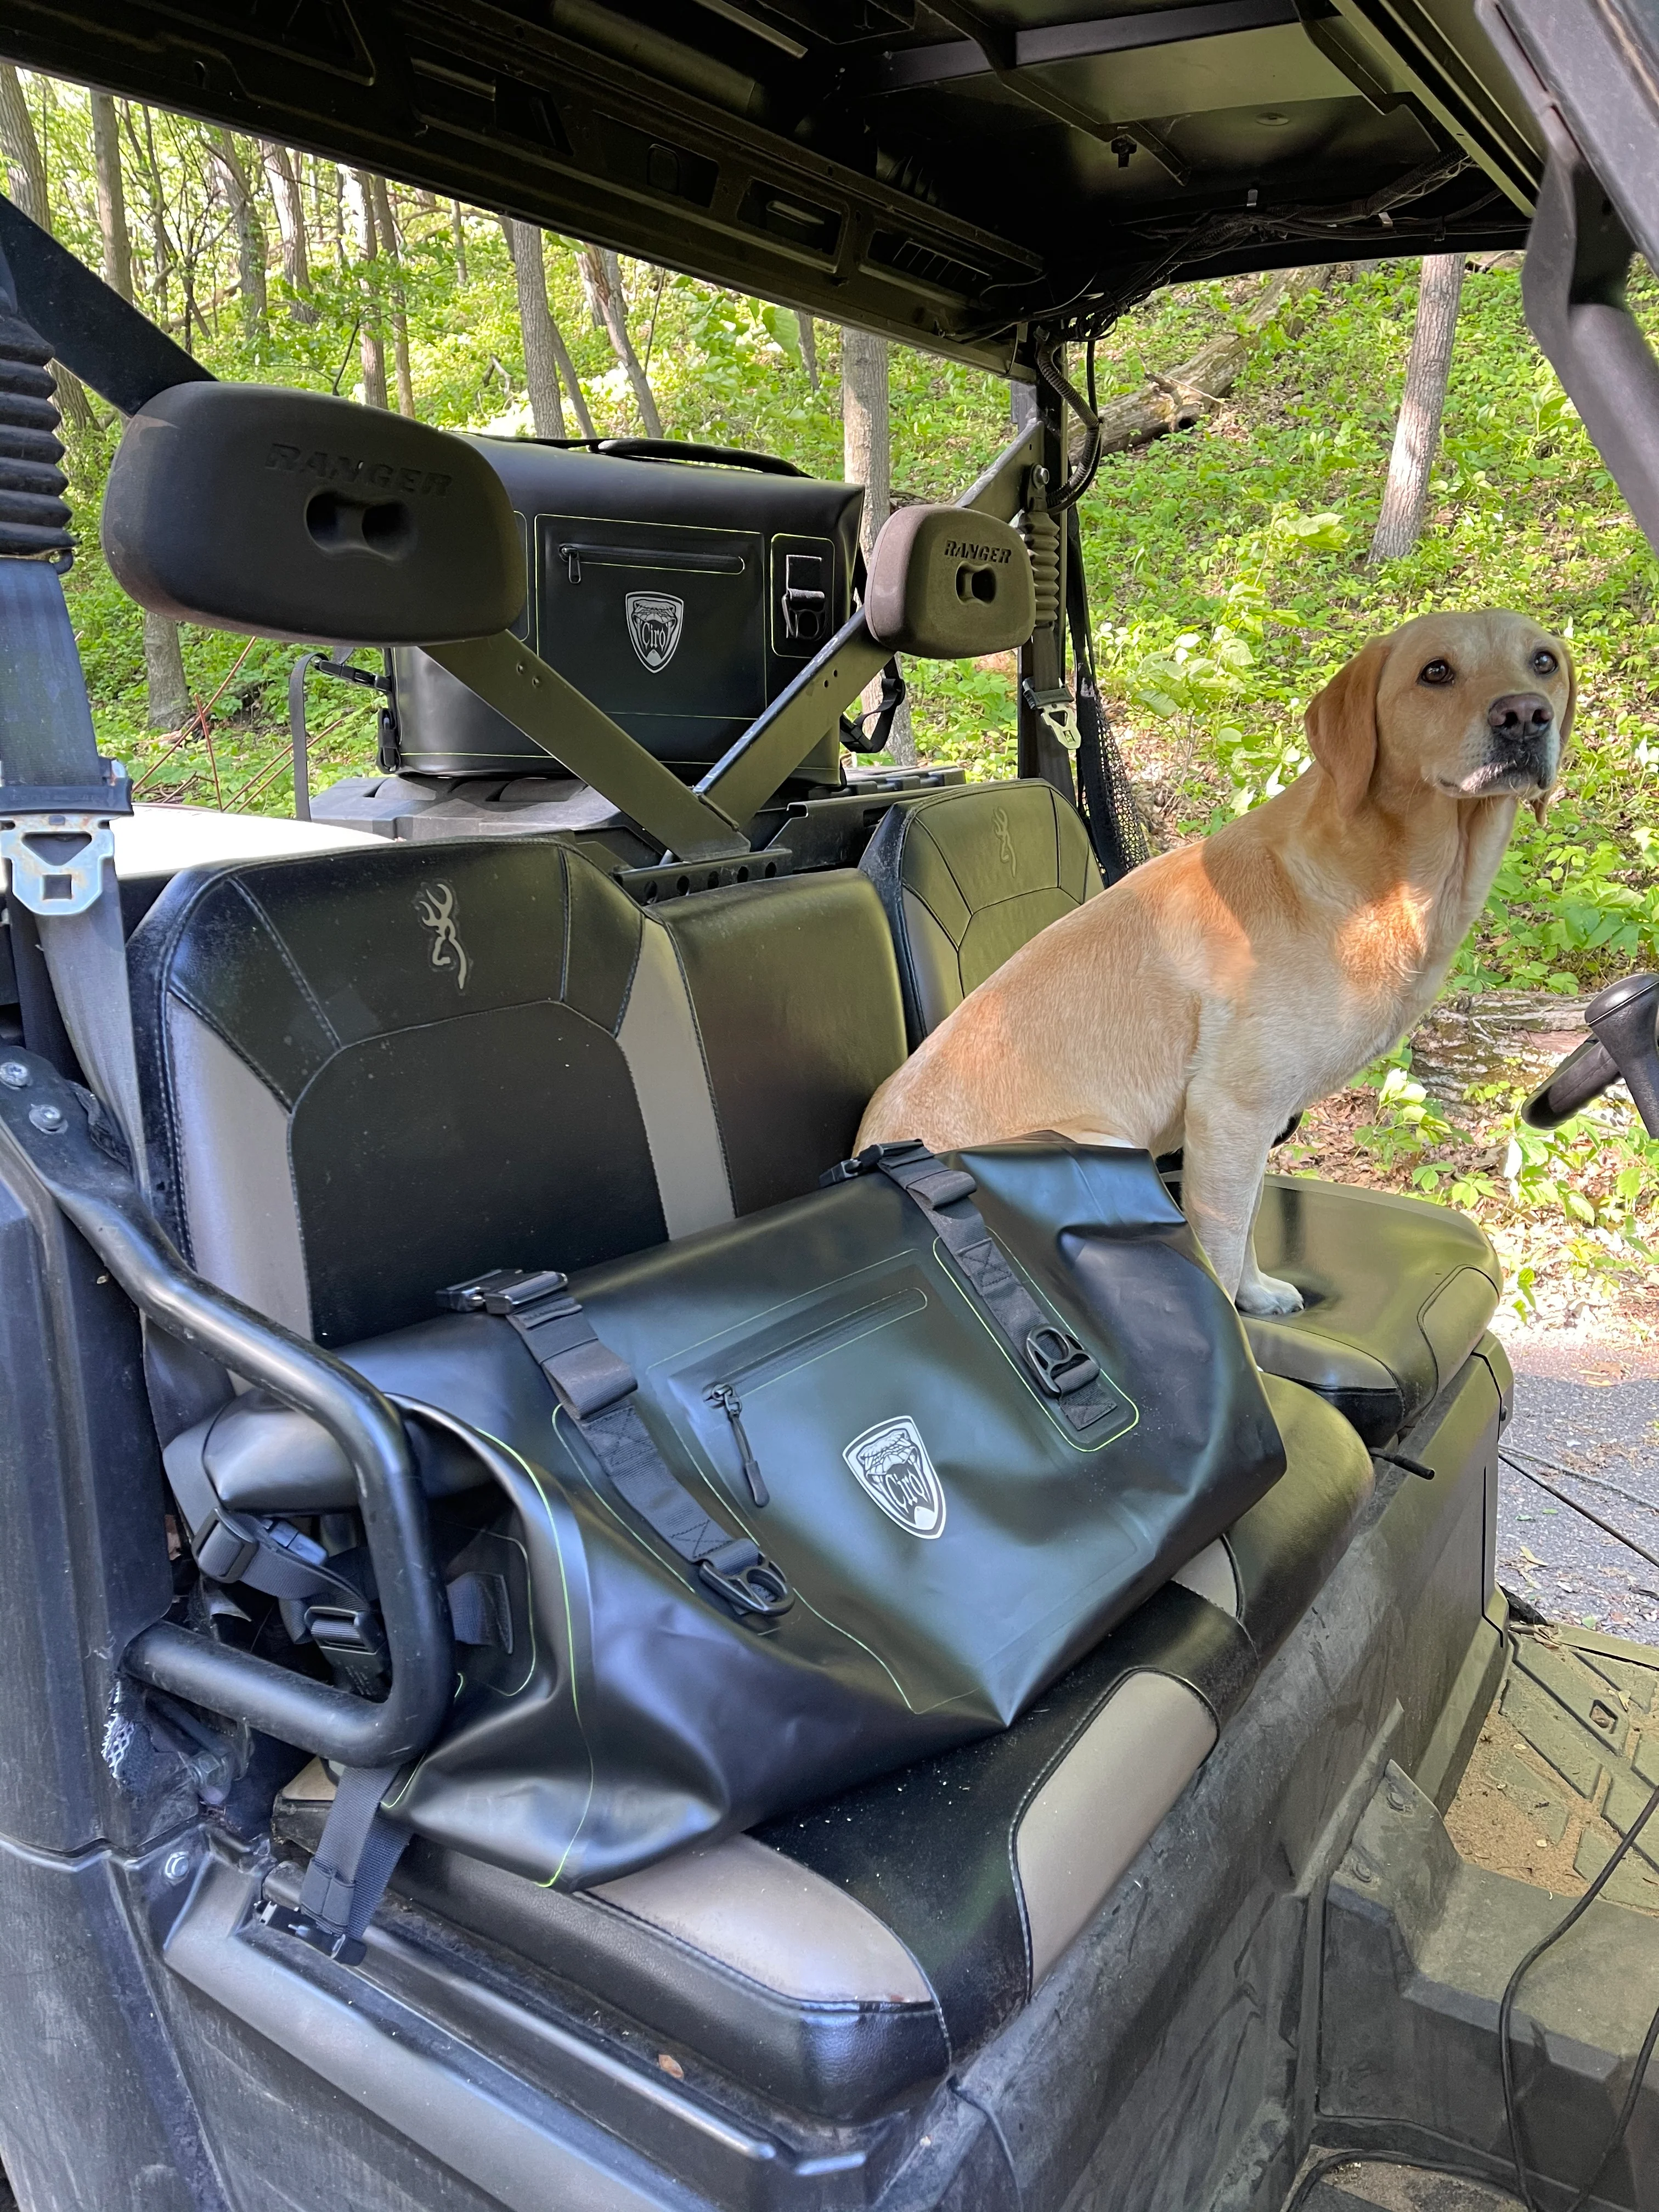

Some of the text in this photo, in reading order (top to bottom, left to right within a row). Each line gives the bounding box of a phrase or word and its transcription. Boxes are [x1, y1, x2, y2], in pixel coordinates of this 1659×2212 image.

[264, 443, 453, 499] RANGER
[944, 539, 1012, 563] RANGER
[642, 622, 666, 652] Ciro
[884, 1468, 928, 1513] Ciro
